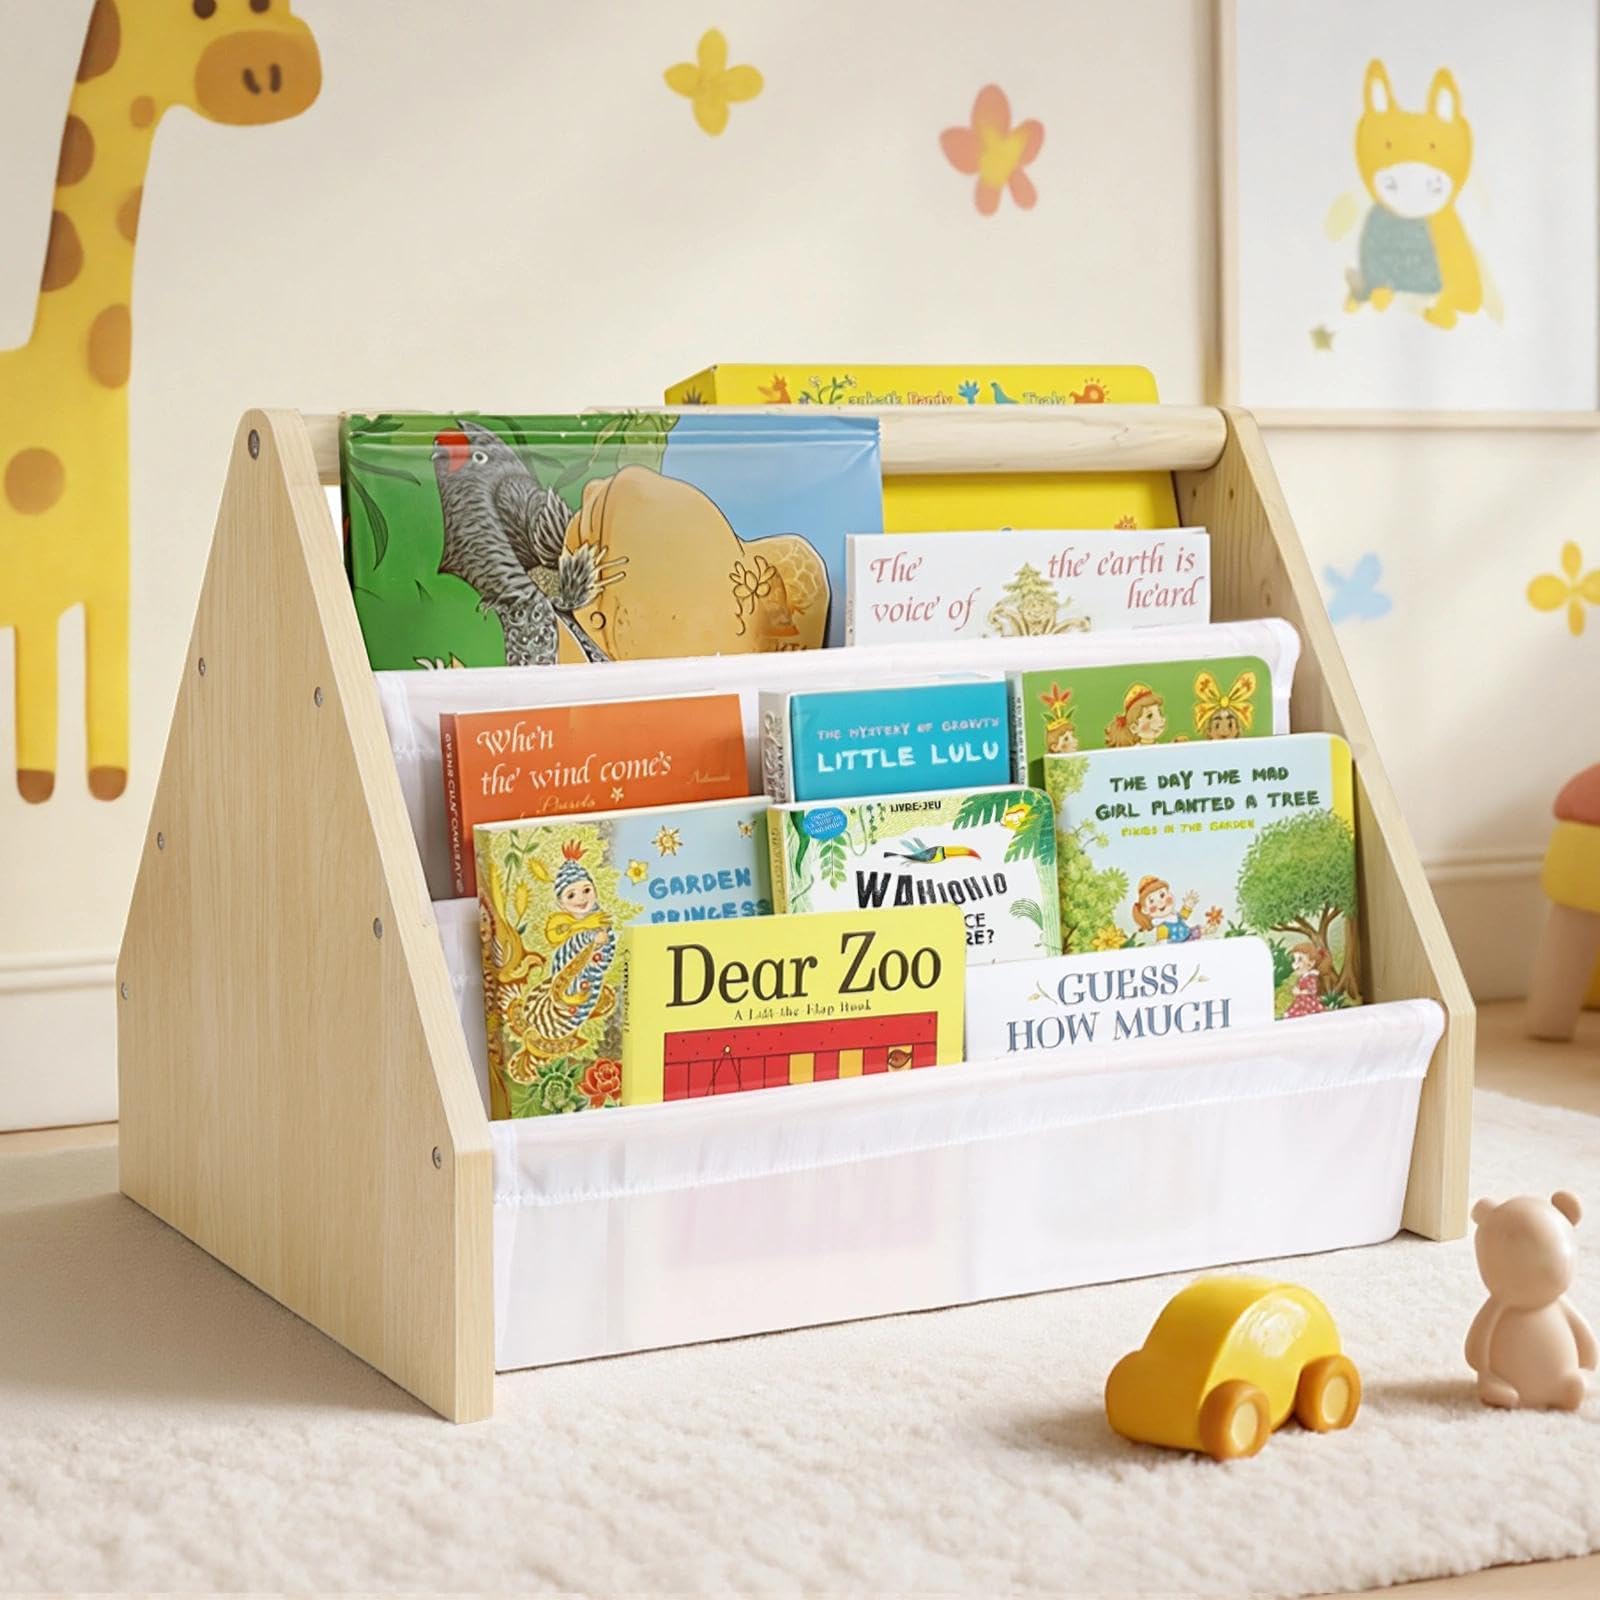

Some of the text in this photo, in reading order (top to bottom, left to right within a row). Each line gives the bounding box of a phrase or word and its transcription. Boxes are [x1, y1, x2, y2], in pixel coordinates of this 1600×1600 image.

[1175, 546, 1197, 573] is
[949, 587, 982, 632] of
[817, 729, 842, 740] THE
[528, 753, 598, 791] wind
[817, 741, 999, 773] LITTLE LULU
[1109, 766, 1290, 793] THE DAY THE MAD
[889, 800, 942, 813] LIVRE-JEU
[1095, 790, 1321, 821] GIRL PLANTED A TREE
[1179, 821, 1203, 833] THE
[648, 867, 752, 900] GARDEN
[666, 930, 942, 1008] Dear Zoo
[1057, 963, 1180, 1007] GUESS
[735, 1009, 743, 1021] A
[1006, 998, 1233, 1053] HOW MUCH
